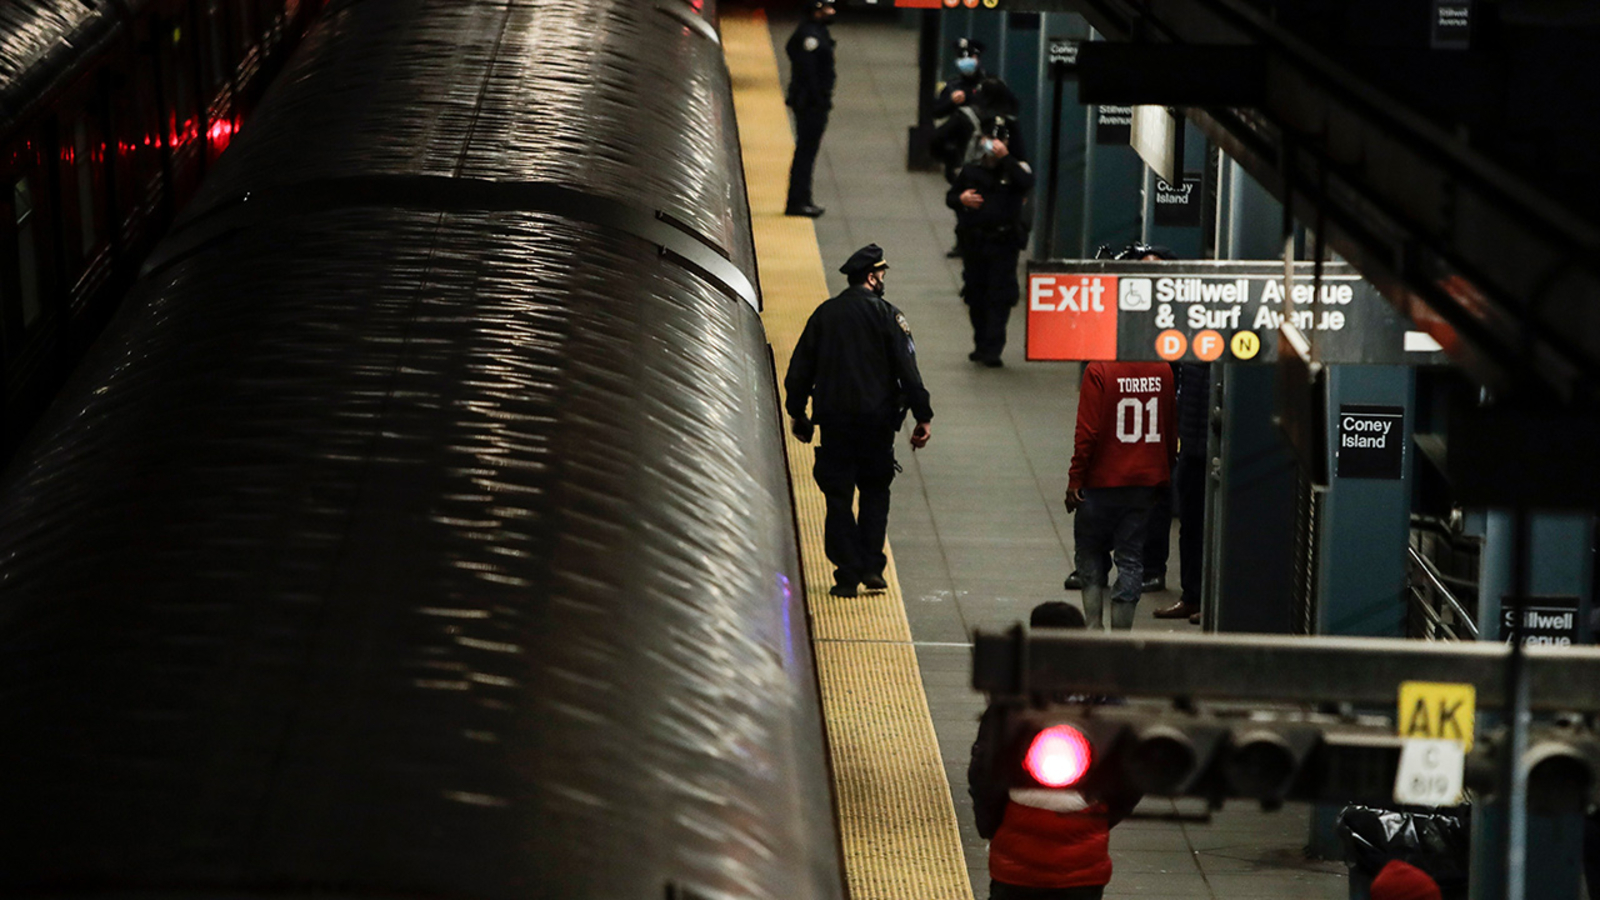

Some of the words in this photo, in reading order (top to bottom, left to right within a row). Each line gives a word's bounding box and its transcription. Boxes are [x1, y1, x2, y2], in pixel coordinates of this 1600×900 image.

[1157, 180, 1194, 194] Coy
[1156, 192, 1189, 204] Island
[1031, 277, 1105, 312] Exit
[1156, 278, 1249, 303] Stillwell
[1155, 304, 1175, 329] &
[1187, 304, 1241, 329] Surf
[1164, 336, 1180, 354] D
[1201, 336, 1216, 354] F
[1239, 338, 1252, 352] N
[1117, 376, 1162, 393] TORRES
[1116, 397, 1161, 443] 01
[1342, 416, 1392, 435] Coney
[1341, 433, 1386, 449] Island
[1504, 610, 1574, 630] Sillwell
[1407, 697, 1465, 739] AK
